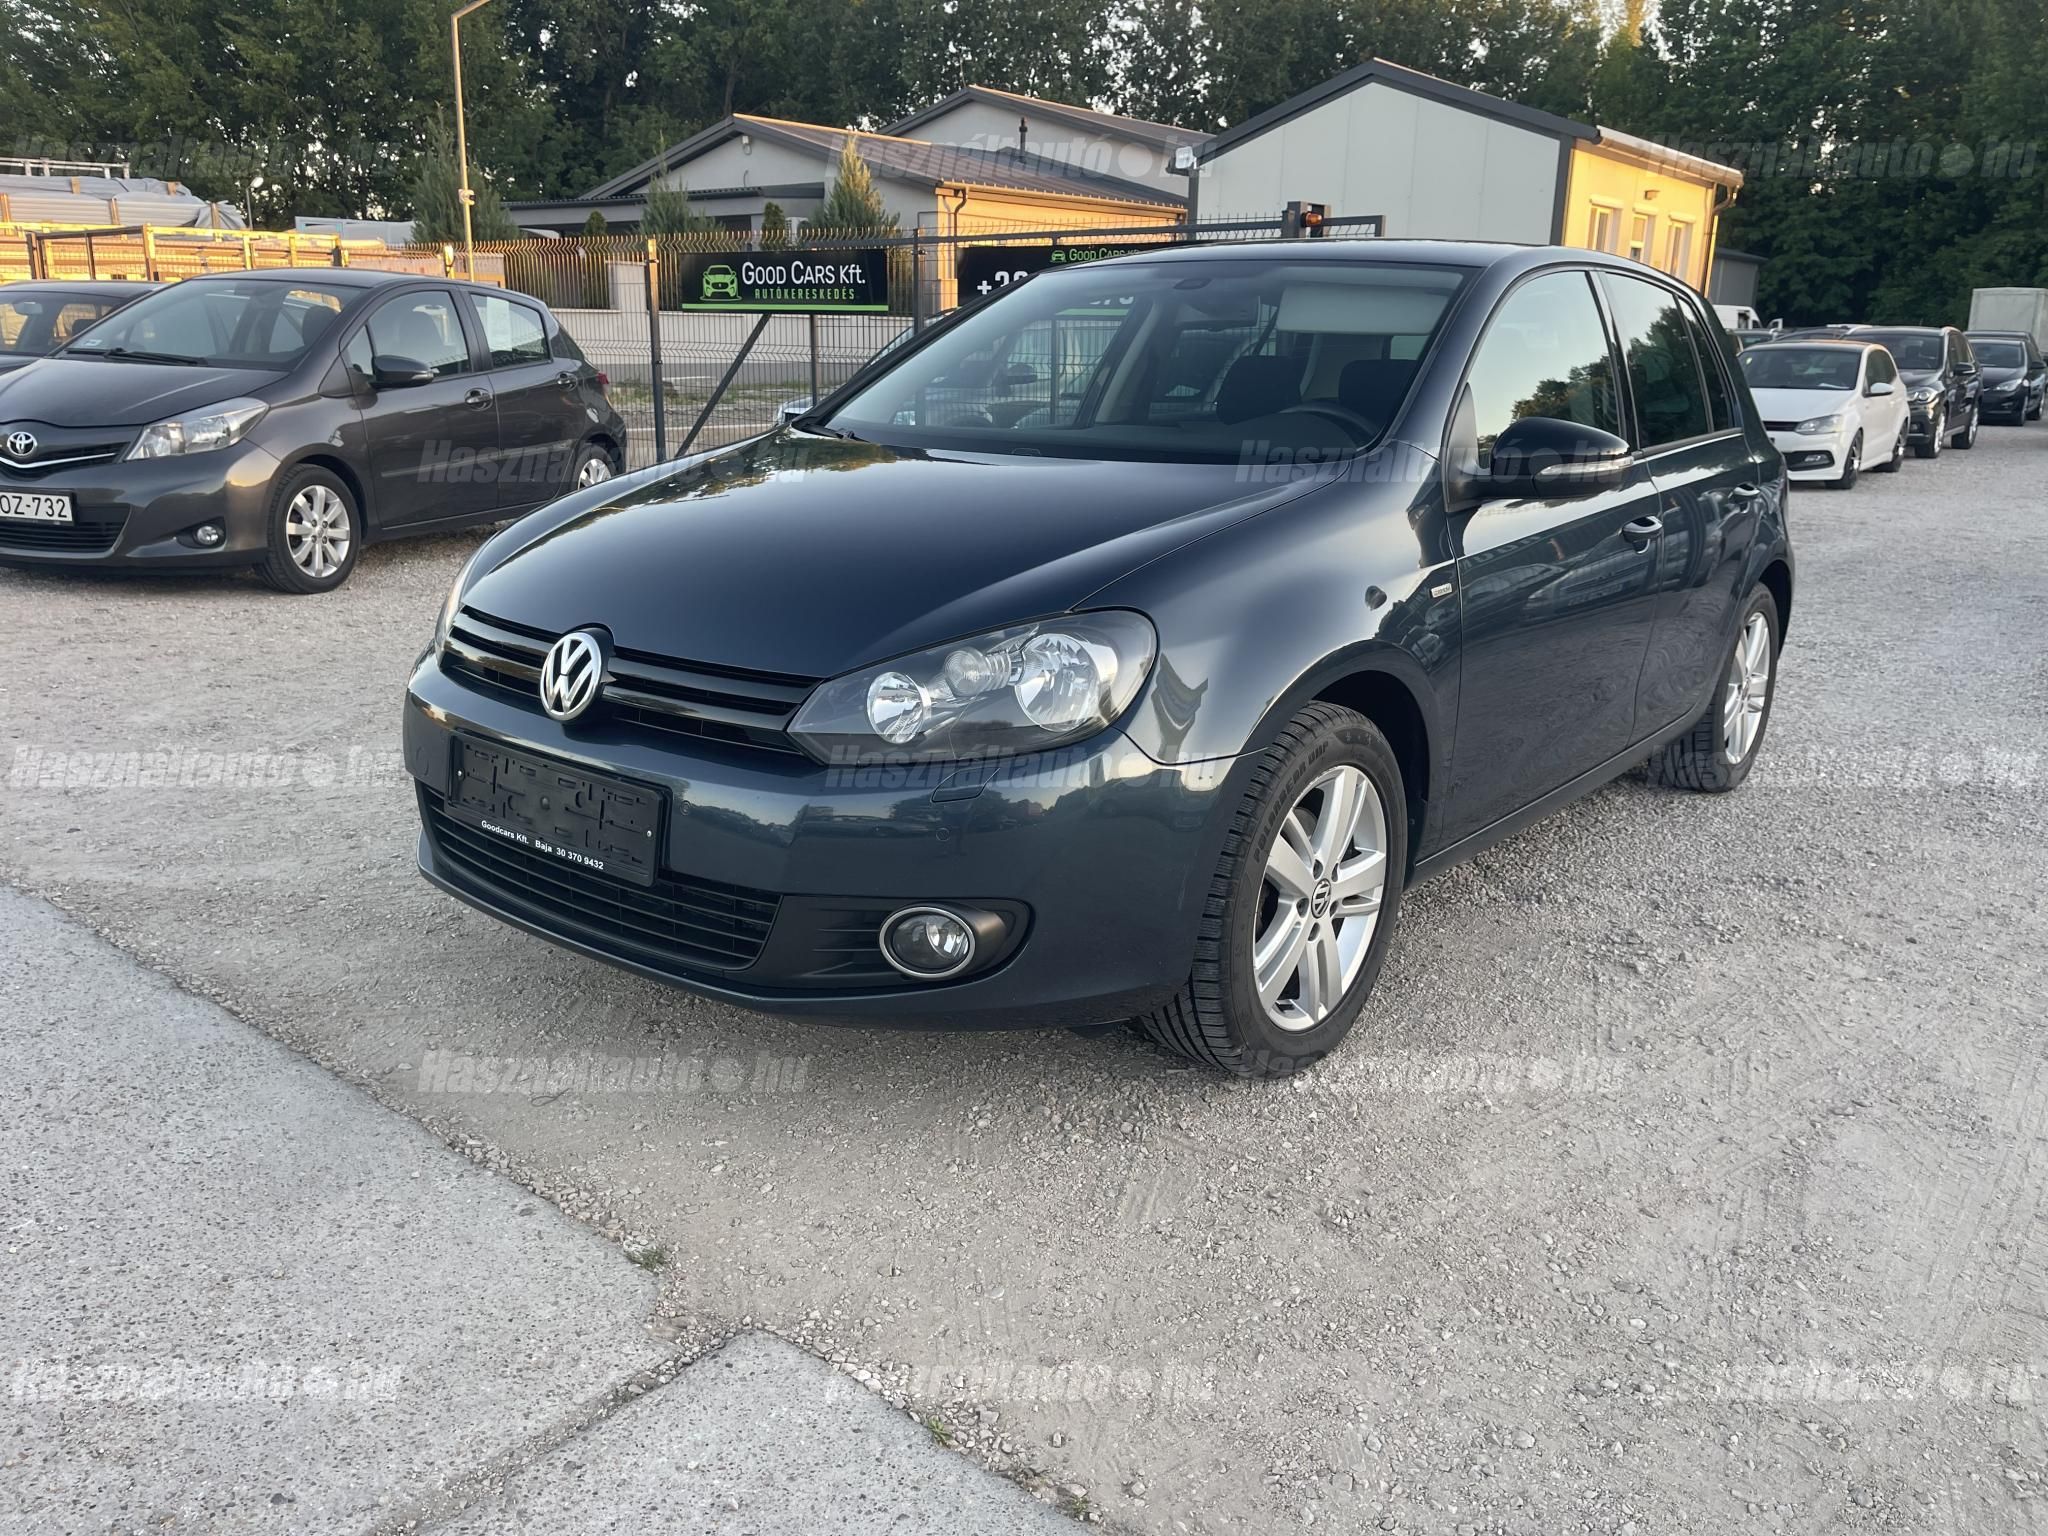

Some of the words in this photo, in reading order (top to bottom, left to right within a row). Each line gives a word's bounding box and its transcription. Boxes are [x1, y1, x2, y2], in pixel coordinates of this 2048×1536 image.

[839, 264, 866, 284] Kft.
[754, 286, 855, 300] AUTÓKERESKEDÉS
[0, 494, 68, 519] OZ-732
[481, 820, 515, 839] Goodcars
[516, 833, 529, 844] Kft.
[535, 839, 553, 853] Baja
[556, 847, 566, 857] 30
[567, 851, 582, 863] 370
[583, 857, 604, 870] 9432
